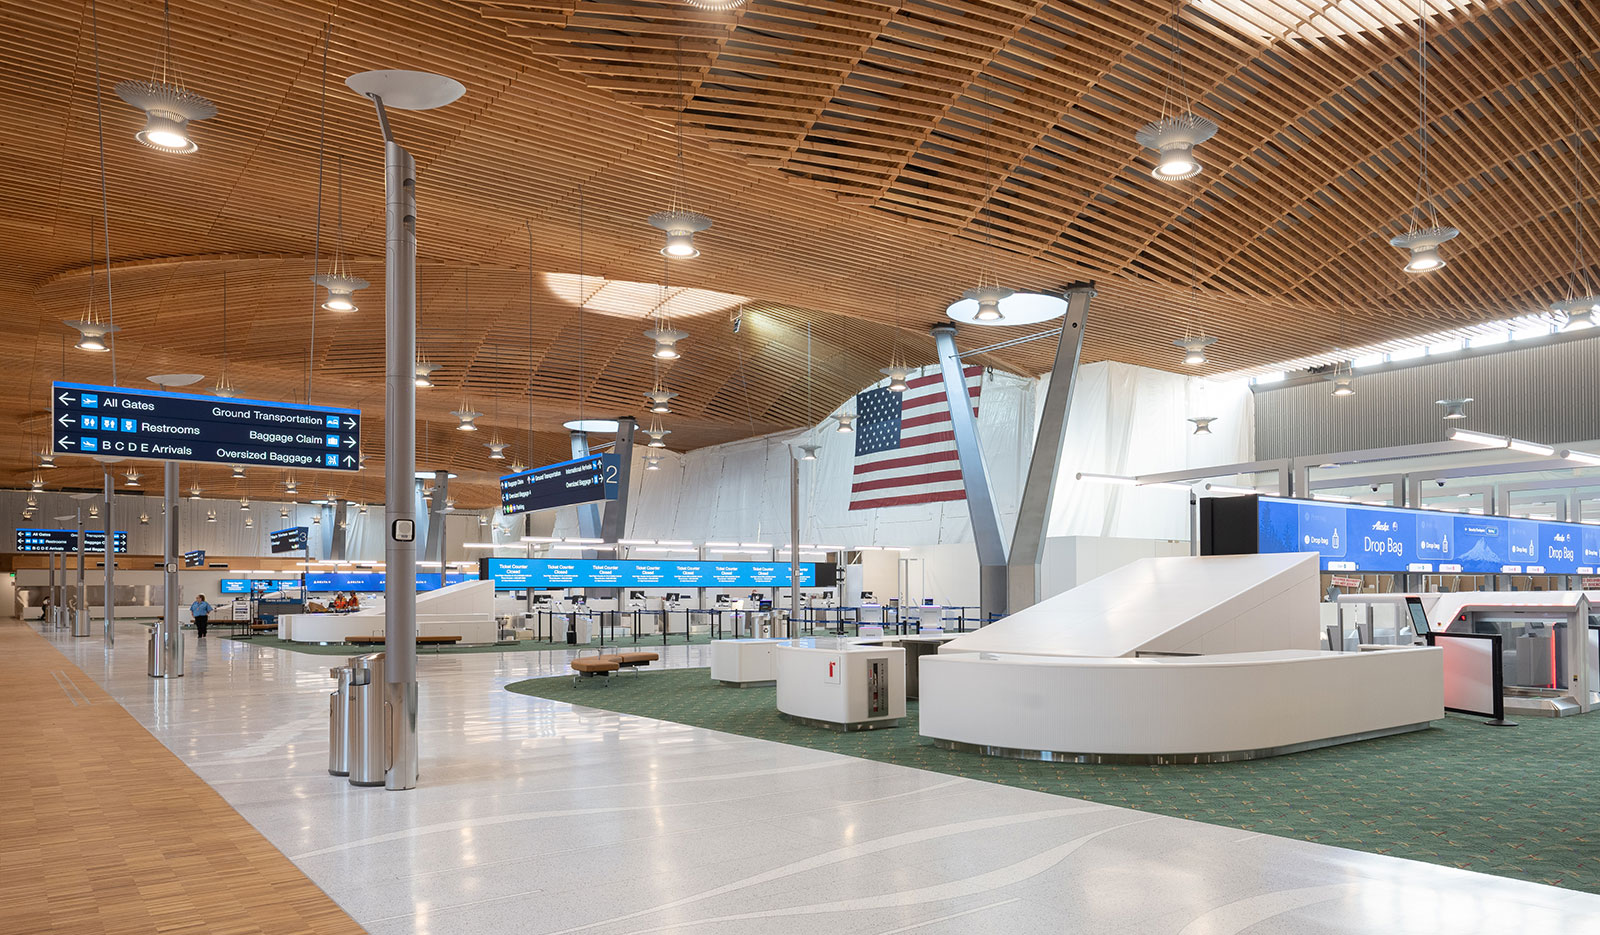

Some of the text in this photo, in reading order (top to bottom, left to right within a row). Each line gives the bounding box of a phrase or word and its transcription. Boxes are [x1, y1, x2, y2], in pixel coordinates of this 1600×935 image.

[103, 398, 155, 411] All Gates
[212, 407, 322, 425] Ground Transportation
[142, 422, 200, 435] Restrooms
[250, 430, 322, 445] Baggage Claim
[102, 441, 192, 456] B C D E Arrivals
[216, 448, 266, 460] Oversized
[269, 452, 312, 464] Baggage
[606, 465, 618, 484] 2
[300, 532, 306, 542] 3
[1311, 536, 1321, 545] Drop
[1364, 536, 1403, 557] Drop Bag
[1549, 546, 1574, 562] Drop Bag
